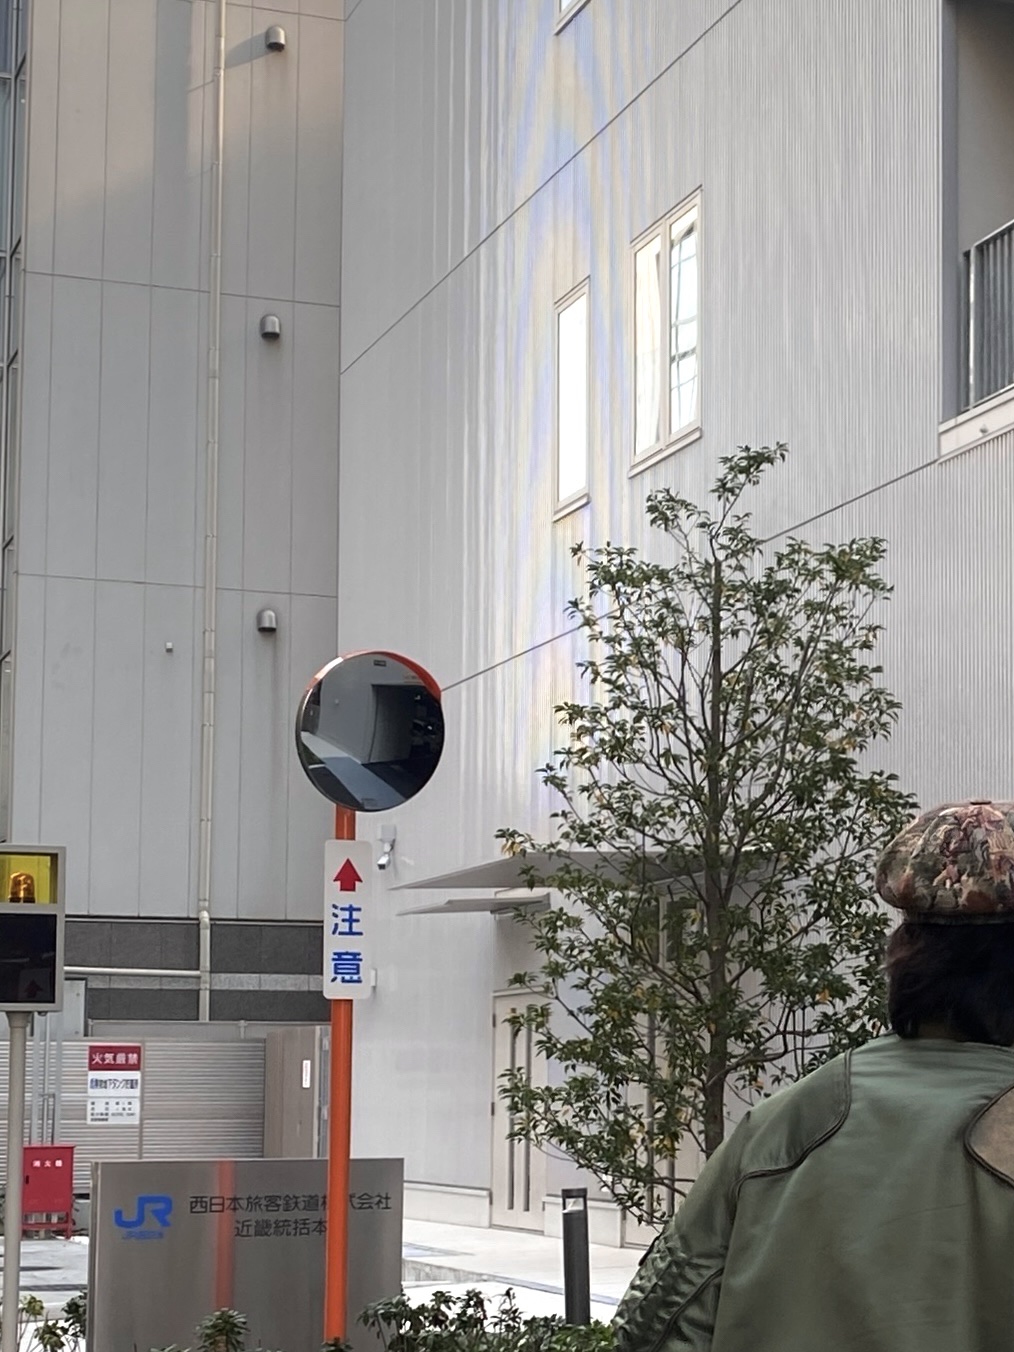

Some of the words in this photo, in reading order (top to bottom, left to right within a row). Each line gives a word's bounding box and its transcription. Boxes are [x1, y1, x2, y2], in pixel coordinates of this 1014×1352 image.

[331, 904, 363, 983] 注意
[92, 1053, 138, 1065] 火気厳禁
[114, 1195, 173, 1228] JR
[234, 1218, 328, 1237] 近畿統括本
